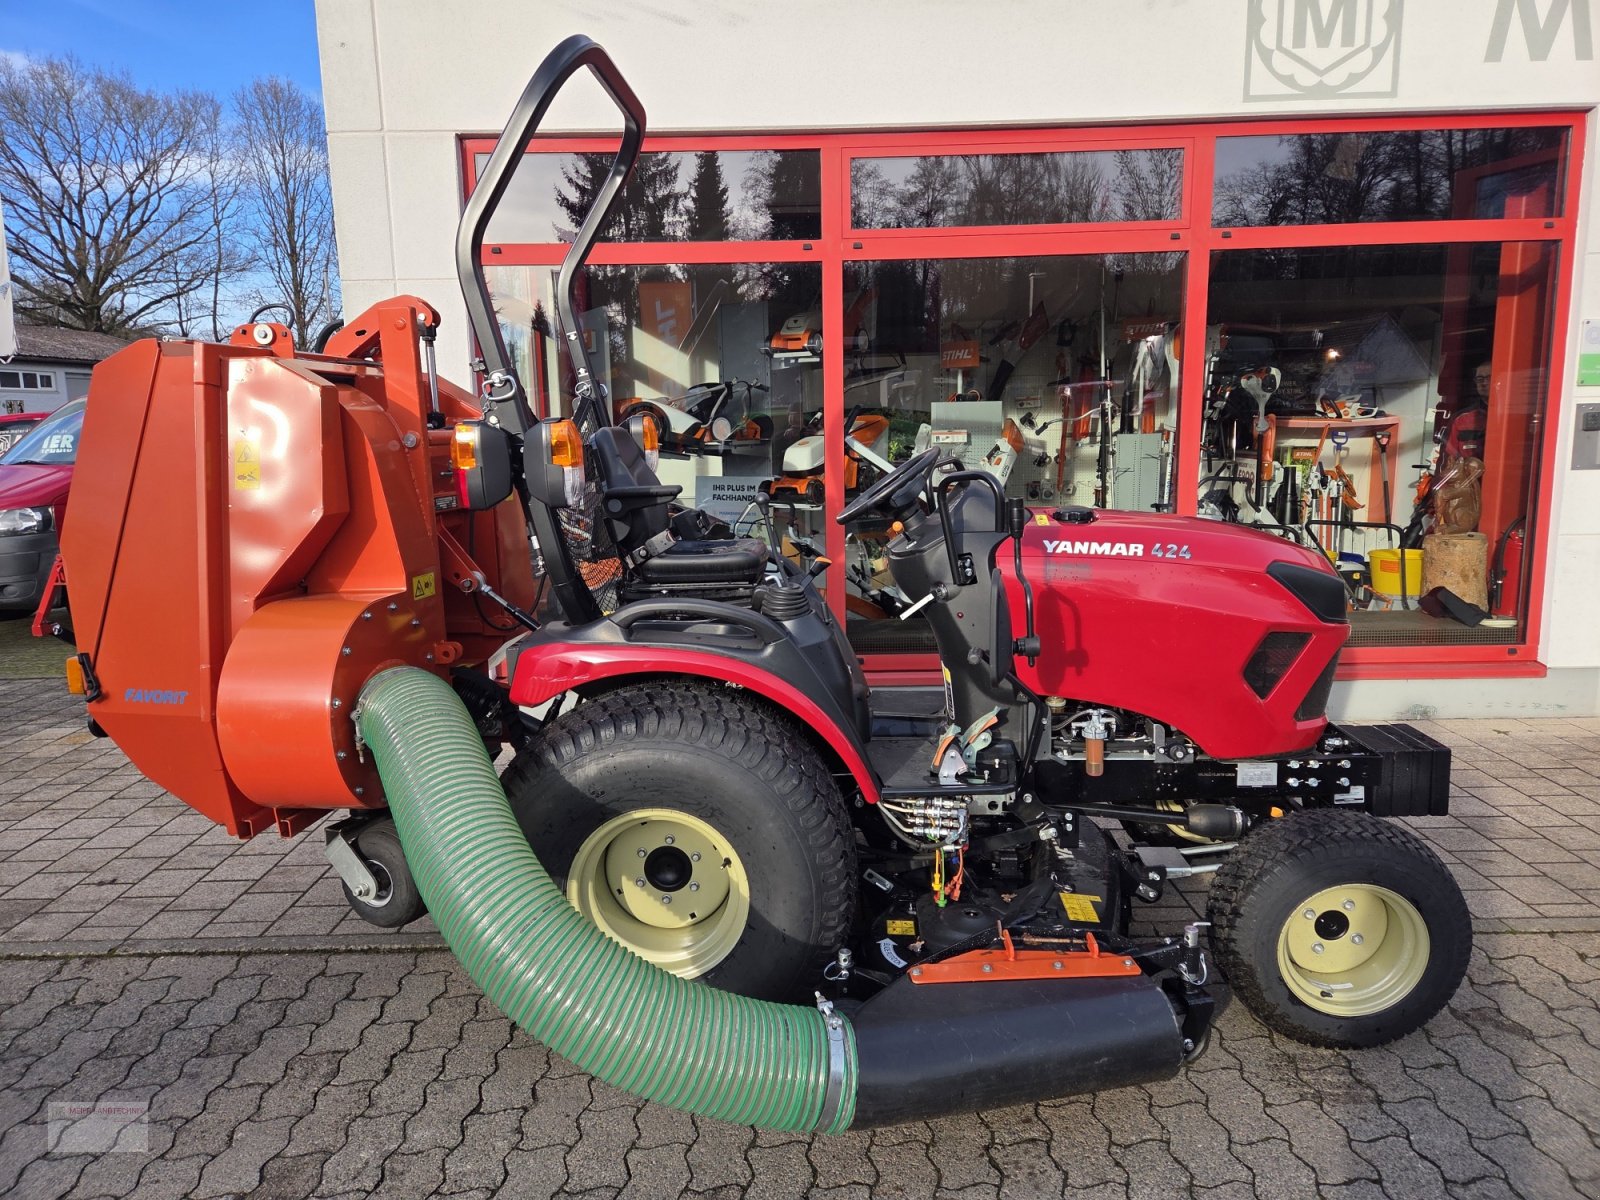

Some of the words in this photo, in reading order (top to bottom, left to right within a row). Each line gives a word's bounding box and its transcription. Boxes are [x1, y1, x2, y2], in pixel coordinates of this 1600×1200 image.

[942, 348, 973, 360] STIHL
[712, 484, 726, 492] IHR
[726, 484, 746, 492] PLUS
[746, 484, 756, 492] IM
[1043, 540, 1144, 557] YANMAR
[1151, 543, 1192, 560] 424
[124, 687, 189, 705] FAVORIT
